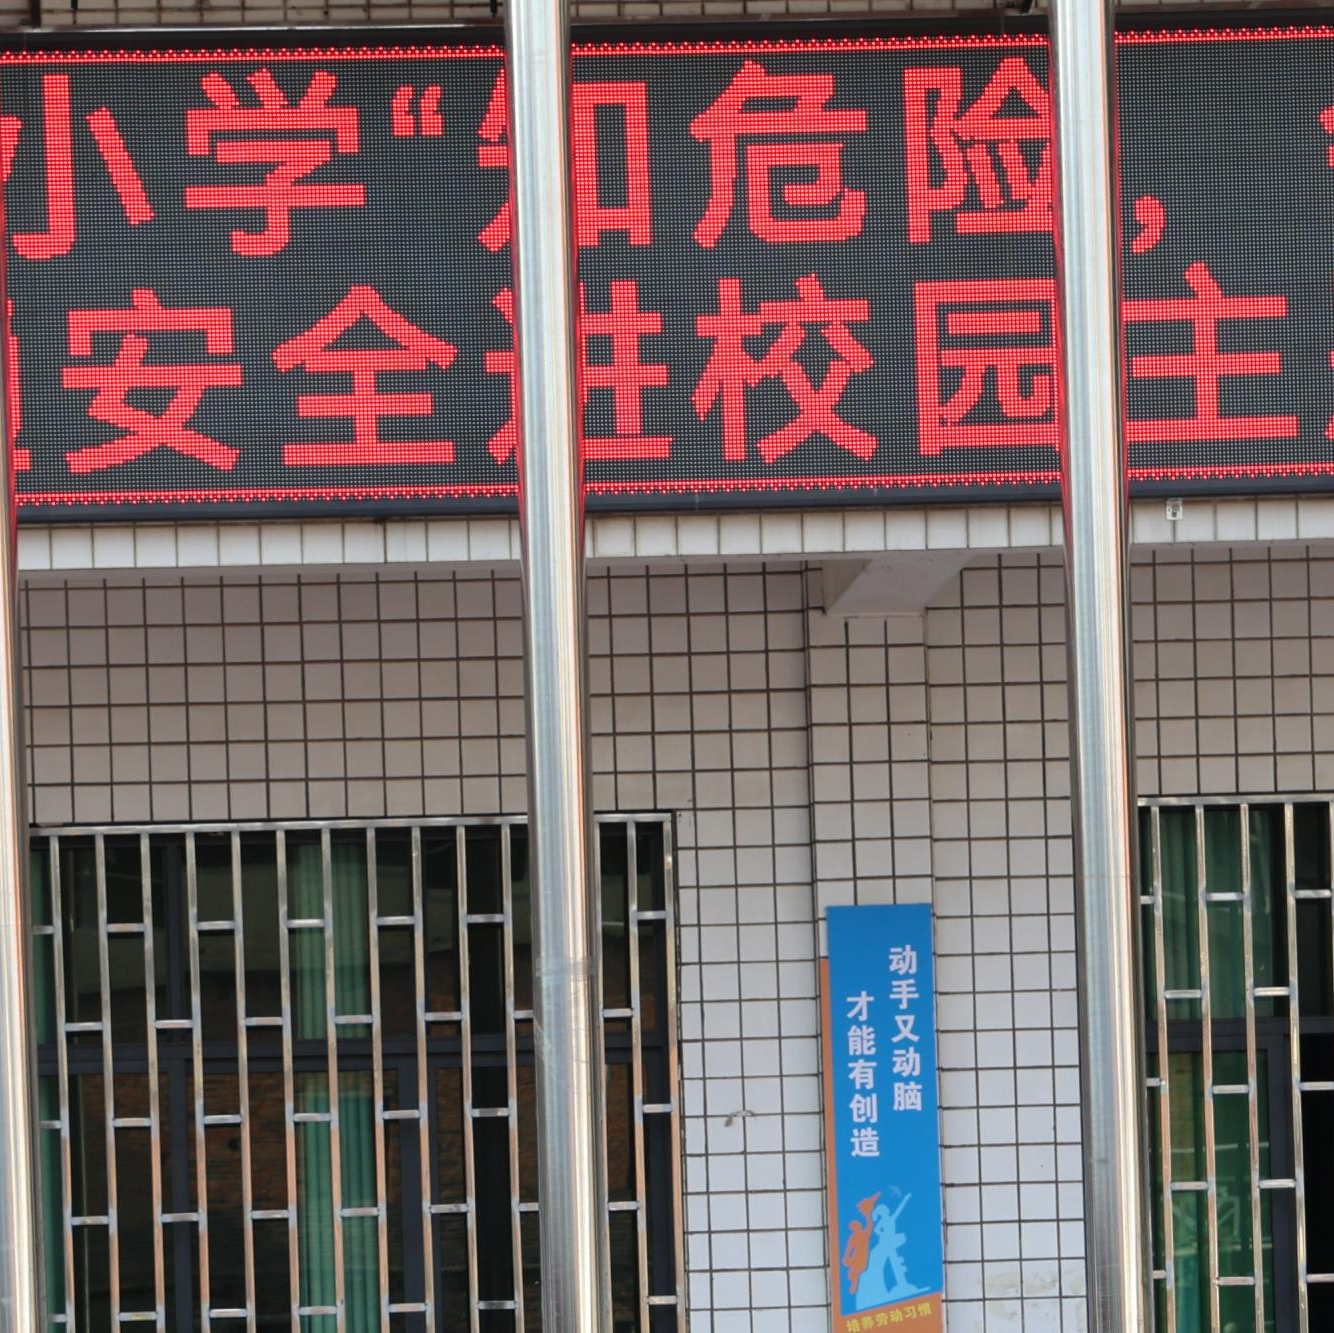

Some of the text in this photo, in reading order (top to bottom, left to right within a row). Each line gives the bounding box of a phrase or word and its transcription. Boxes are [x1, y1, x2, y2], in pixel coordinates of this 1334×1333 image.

[845, 990, 881, 1159] 才能有创造
[888, 943, 923, 1112] 动手又动脑
[845, 1302, 933, 1333] 培养劳动习惯
